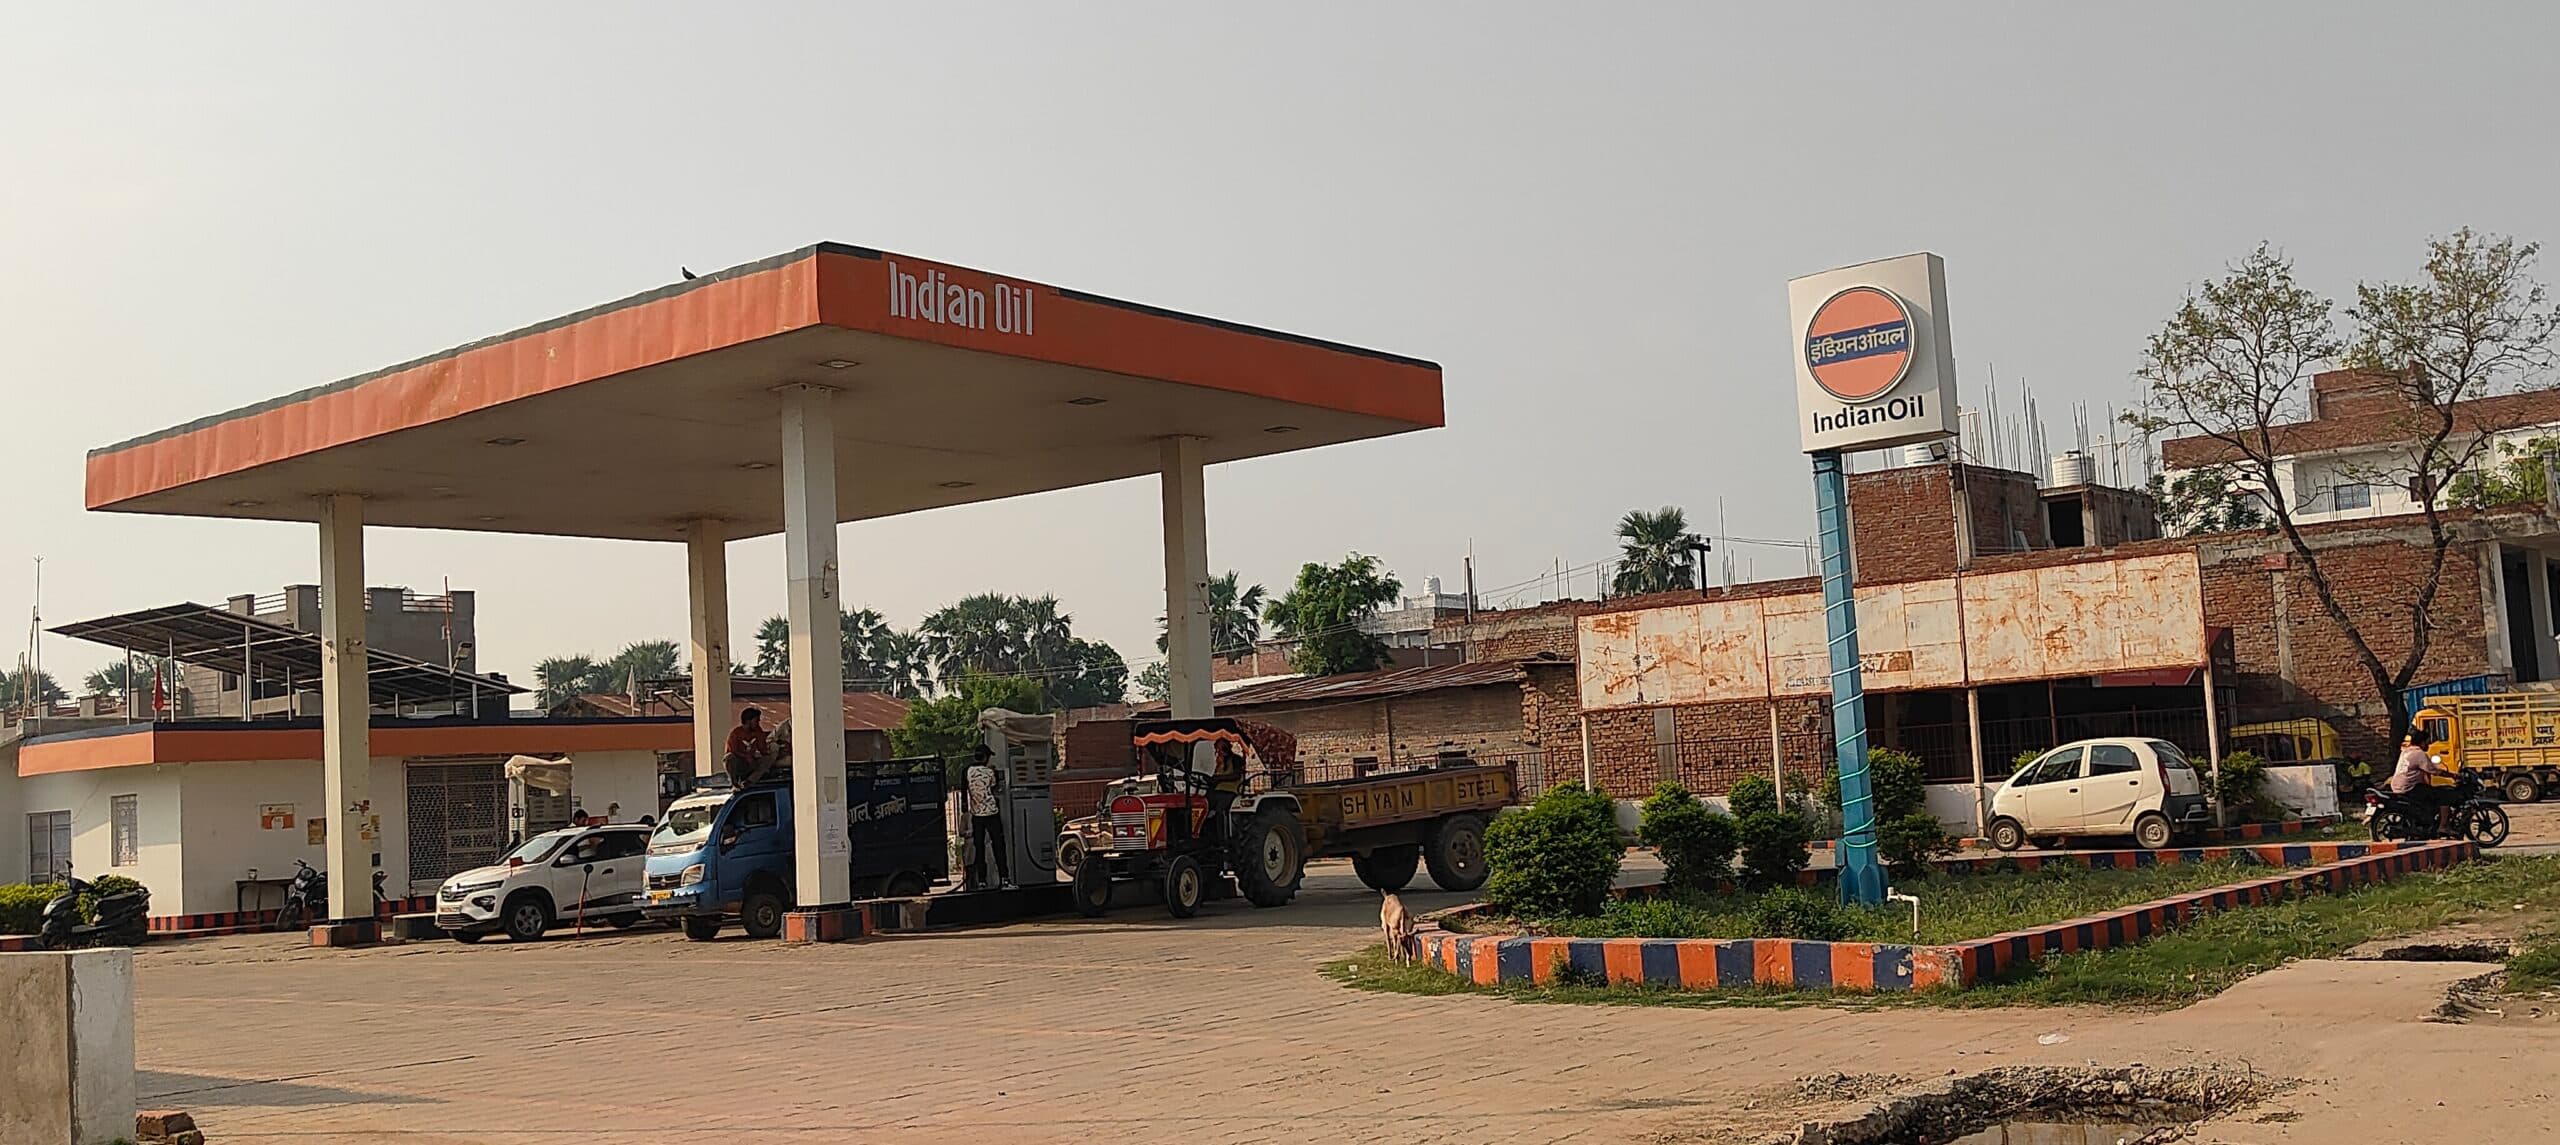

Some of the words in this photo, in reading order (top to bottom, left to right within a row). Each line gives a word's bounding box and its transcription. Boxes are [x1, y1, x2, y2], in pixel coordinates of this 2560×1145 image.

[889, 261, 985, 330] Indian
[995, 283, 1033, 336] Oil
[1809, 326, 1906, 363] इंडियनऑयल
[1813, 395, 1924, 434] IndianOil
[1457, 779, 1499, 799] STEEL
